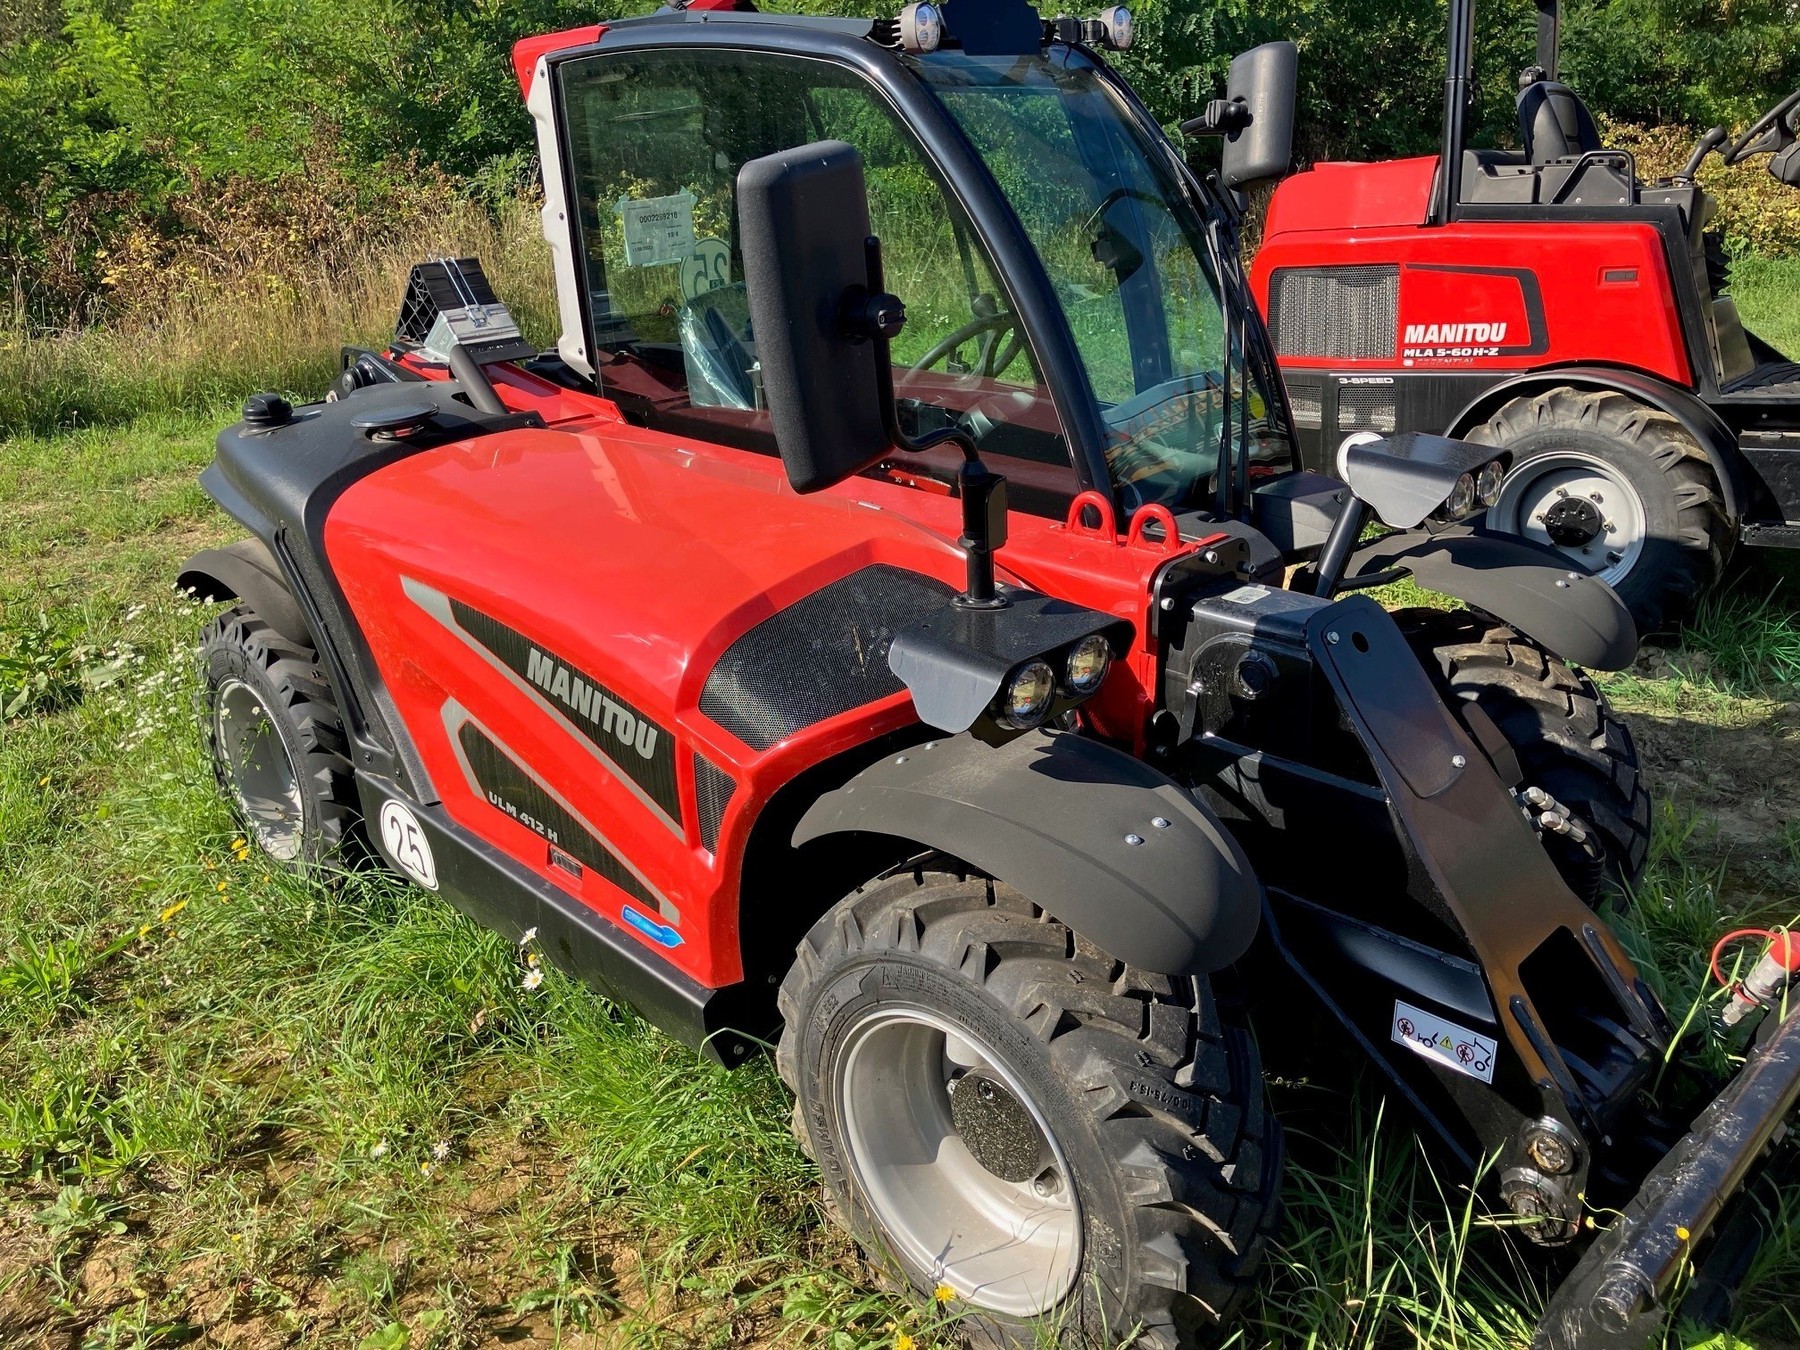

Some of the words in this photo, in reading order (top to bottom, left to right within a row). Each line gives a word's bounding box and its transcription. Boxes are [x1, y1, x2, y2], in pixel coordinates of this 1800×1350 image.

[1403, 347, 1434, 357] MLA
[1404, 322, 1507, 344] MANITOU
[526, 647, 658, 760] MANITOU
[488, 791, 517, 818] ULM
[519, 811, 545, 836] 412
[547, 828, 559, 844] H
[390, 815, 428, 878] 25
